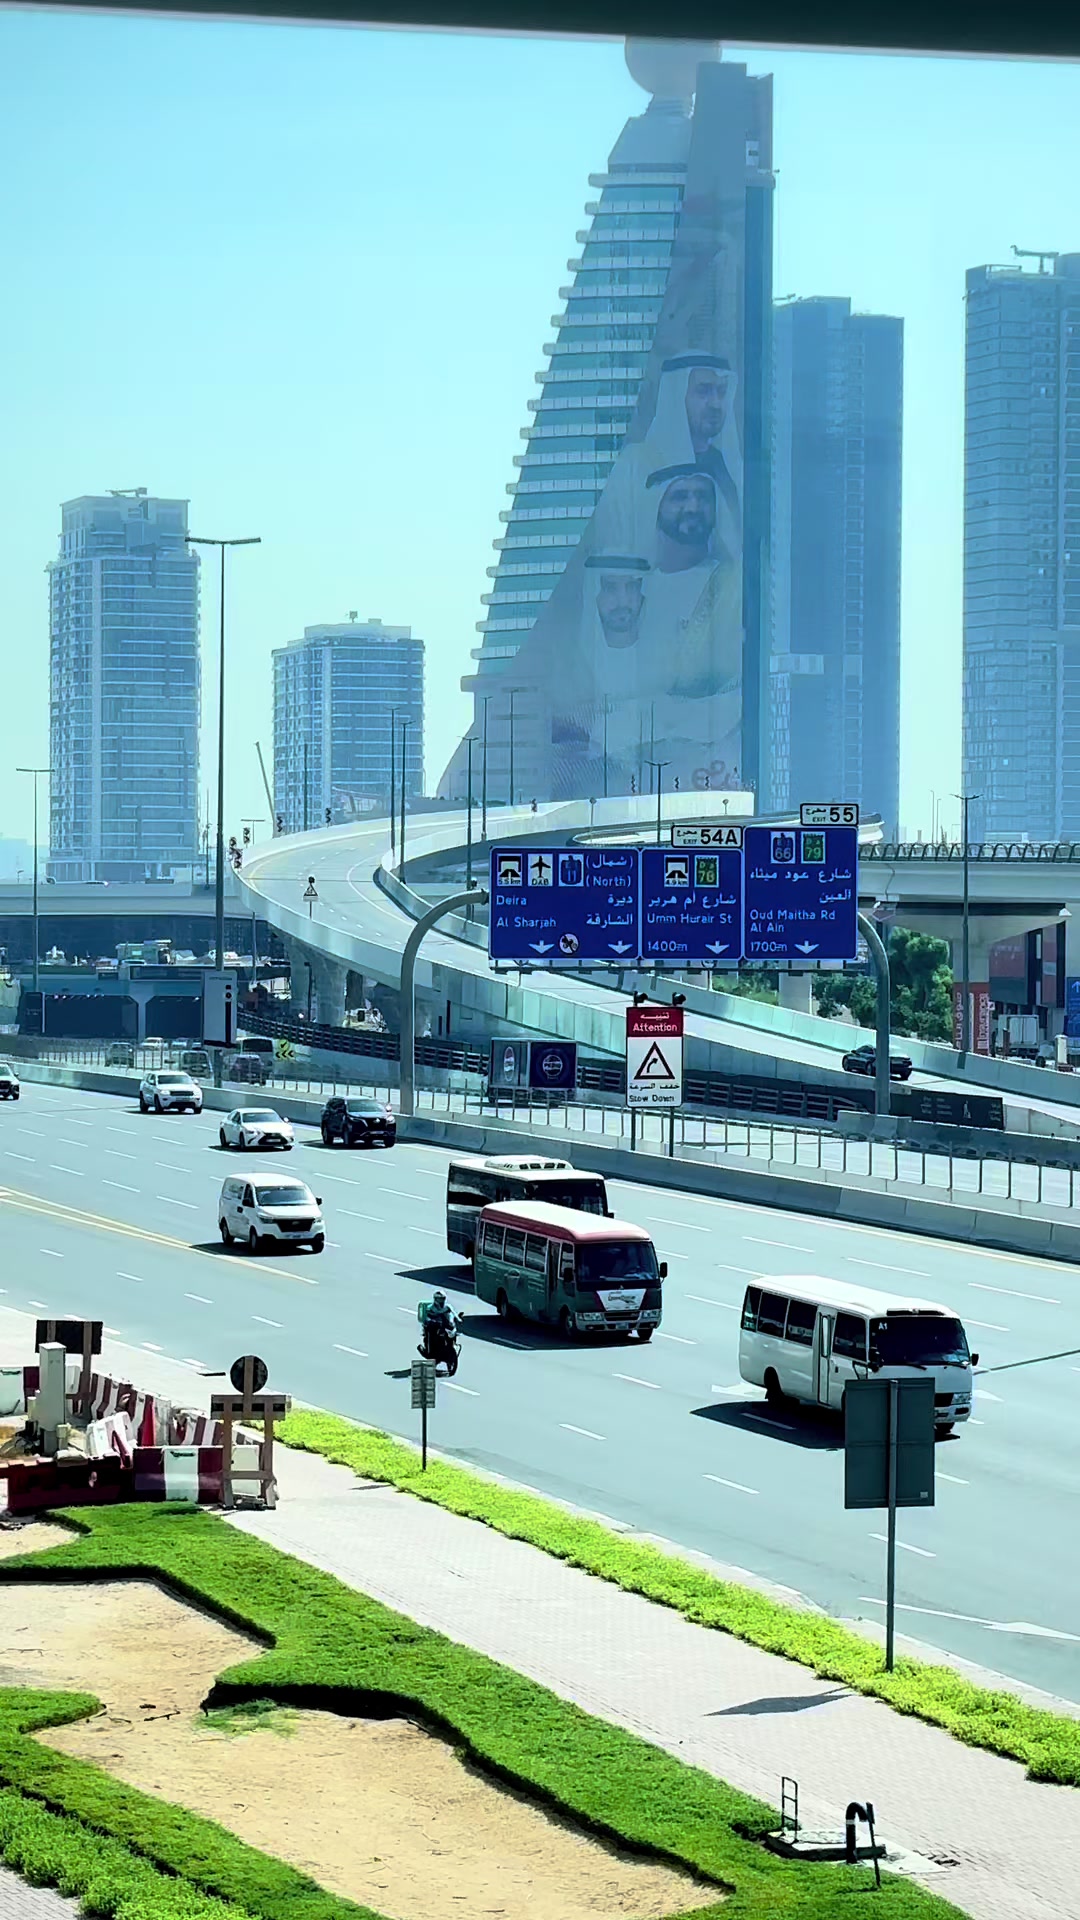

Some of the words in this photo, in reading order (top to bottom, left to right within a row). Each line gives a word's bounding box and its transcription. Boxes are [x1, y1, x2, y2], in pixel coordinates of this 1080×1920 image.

[830, 807, 854, 822] 55
[701, 829, 738, 844] 54A
[775, 848, 792, 859] 66
[805, 847, 822, 858] 79
[785, 871, 809, 882] عود
[818, 868, 852, 883] شارع
[496, 894, 527, 906] Deira
[607, 894, 633, 907] ديرة
[702, 892, 737, 909] شارع
[819, 889, 852, 904] العين
[586, 912, 633, 929] الشارقة
[647, 912, 677, 924] Umm
[680, 912, 715, 924] Hurair
[719, 912, 733, 924] St
[750, 909, 773, 920] Oud
[777, 909, 816, 920] Maitha
[820, 909, 836, 920] Rd
[496, 916, 508, 928] Al
[514, 915, 557, 929] Sharjah
[750, 922, 762, 933] Al
[767, 922, 785, 933] Ain
[632, 1022, 678, 1032] Attention
[629, 1094, 649, 1103] Slow
[652, 1094, 675, 1103] Down
